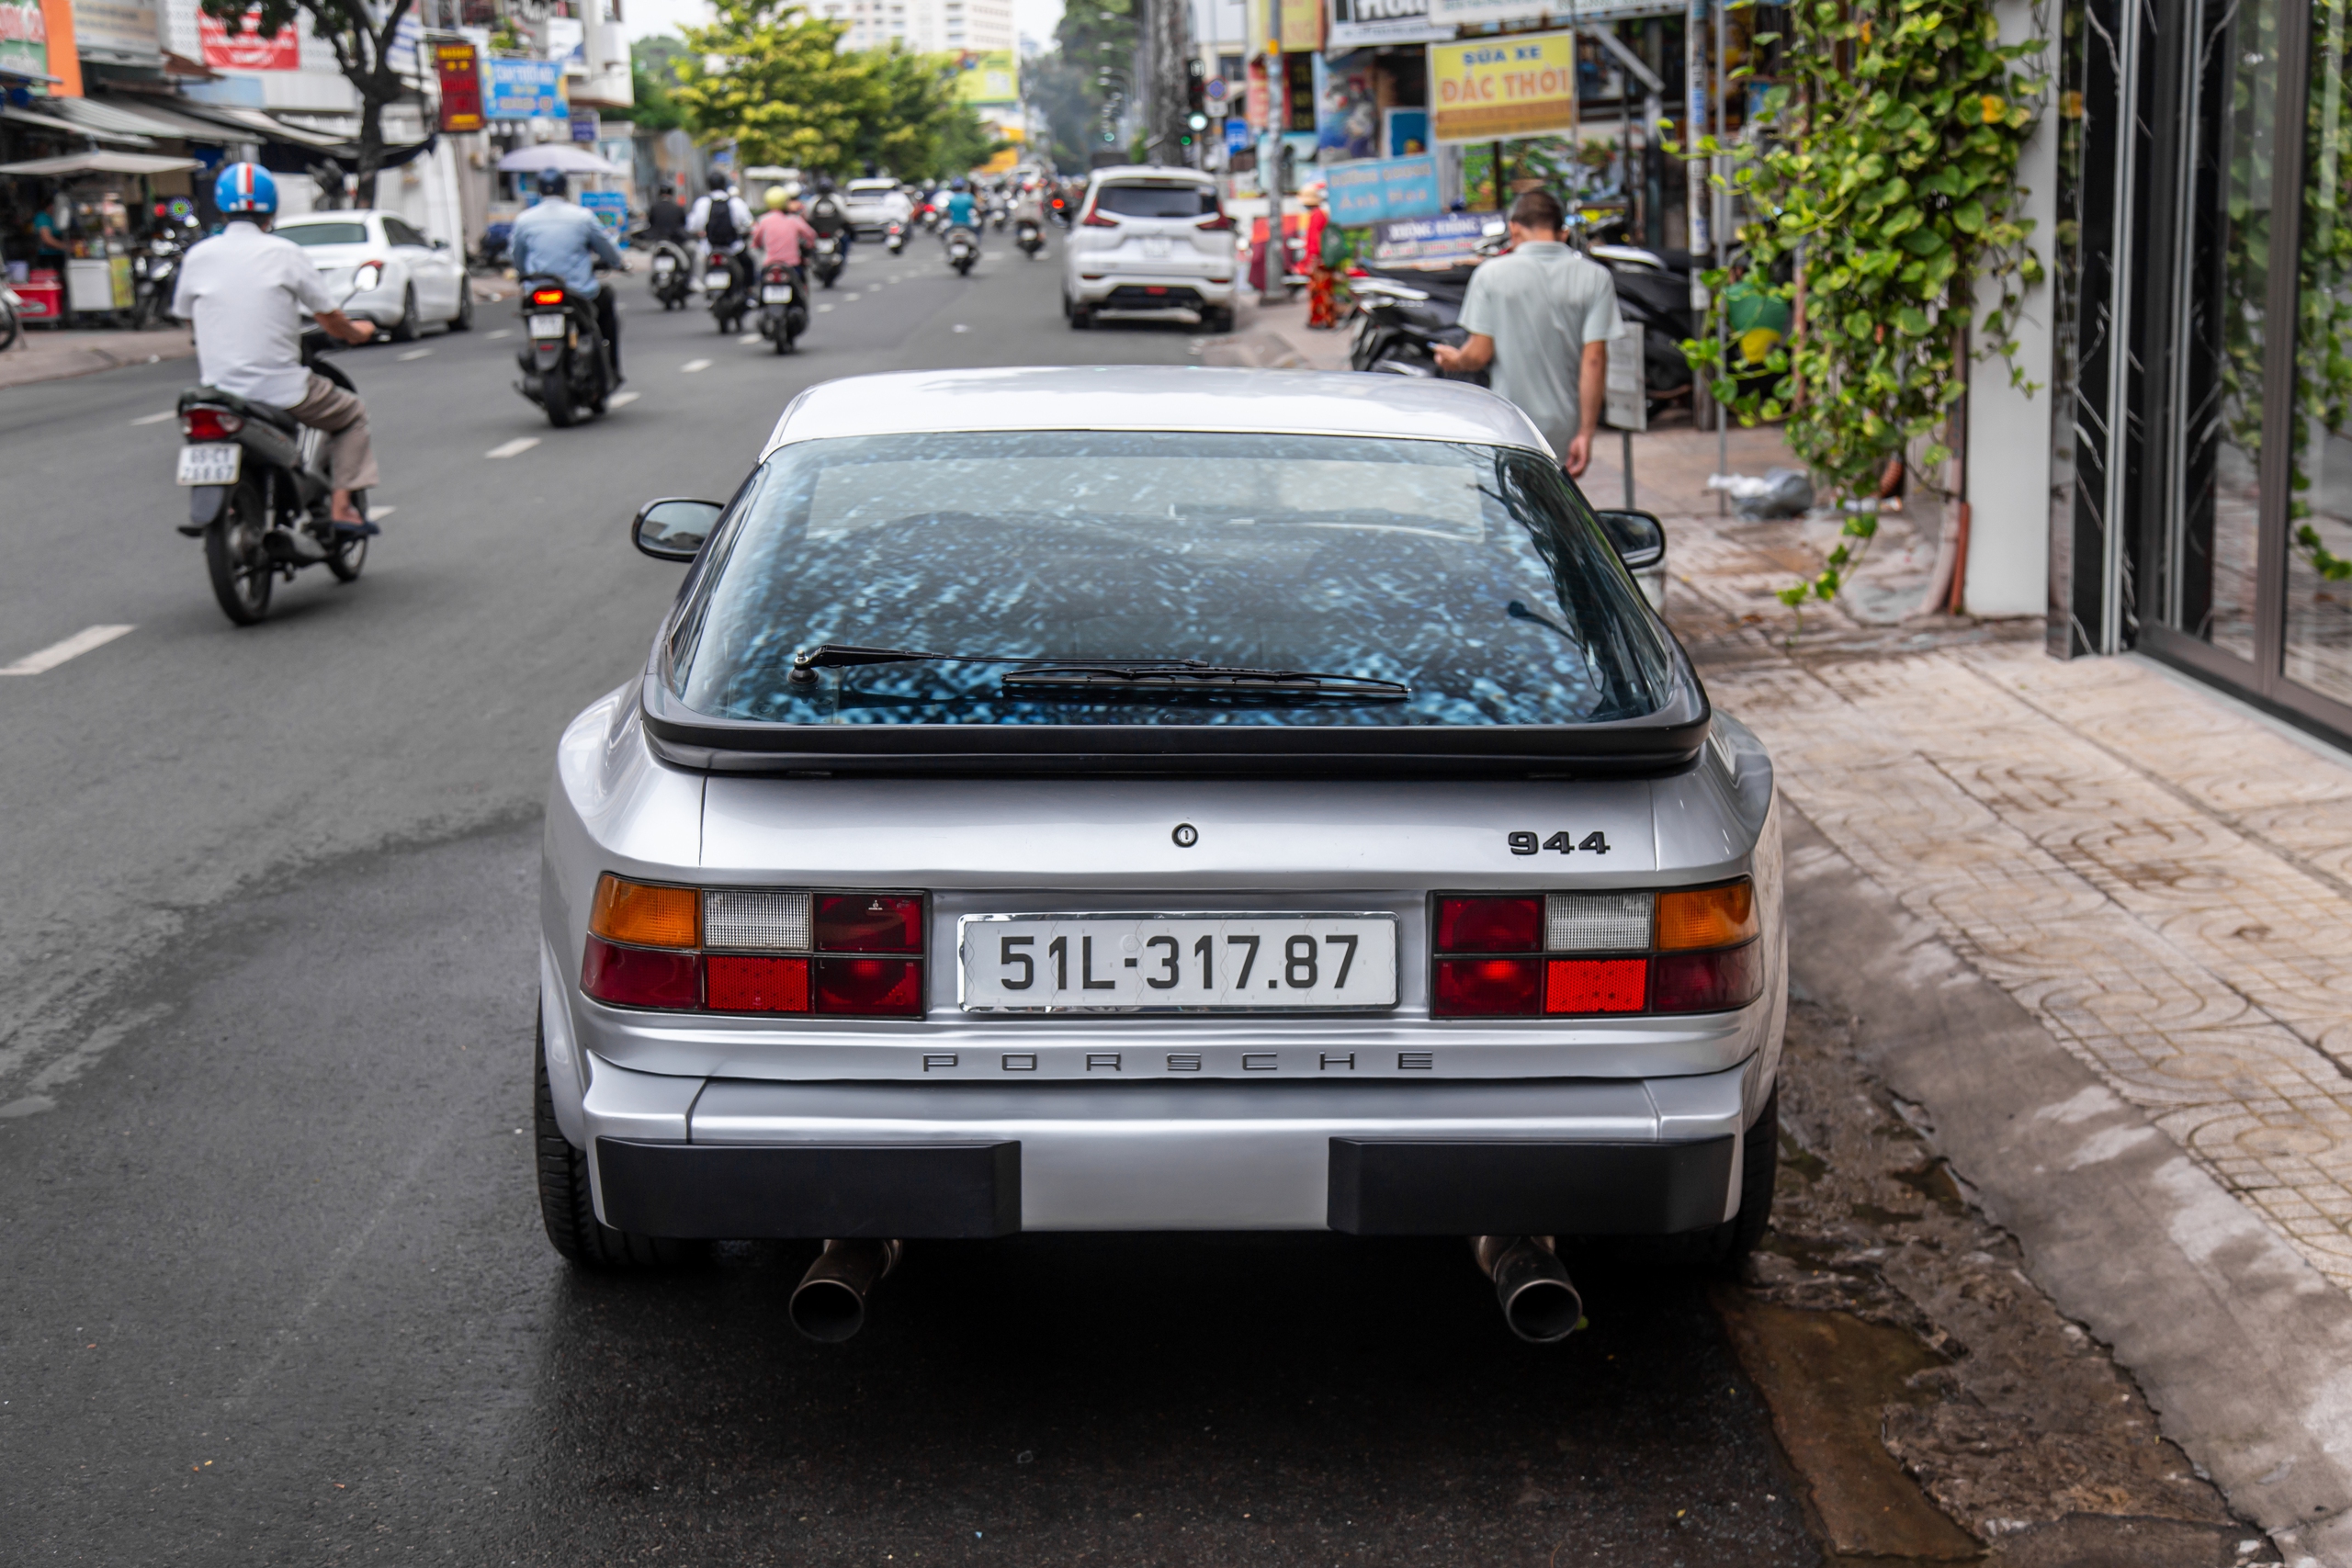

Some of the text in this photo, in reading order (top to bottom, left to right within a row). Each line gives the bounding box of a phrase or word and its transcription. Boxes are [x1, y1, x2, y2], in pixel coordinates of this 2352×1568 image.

[1515, 46, 1542, 60] XE
[1508, 830, 1611, 855] 944
[1001, 934, 1359, 990] 51L-317.87
[922, 1052, 1434, 1072] PORSCHE
